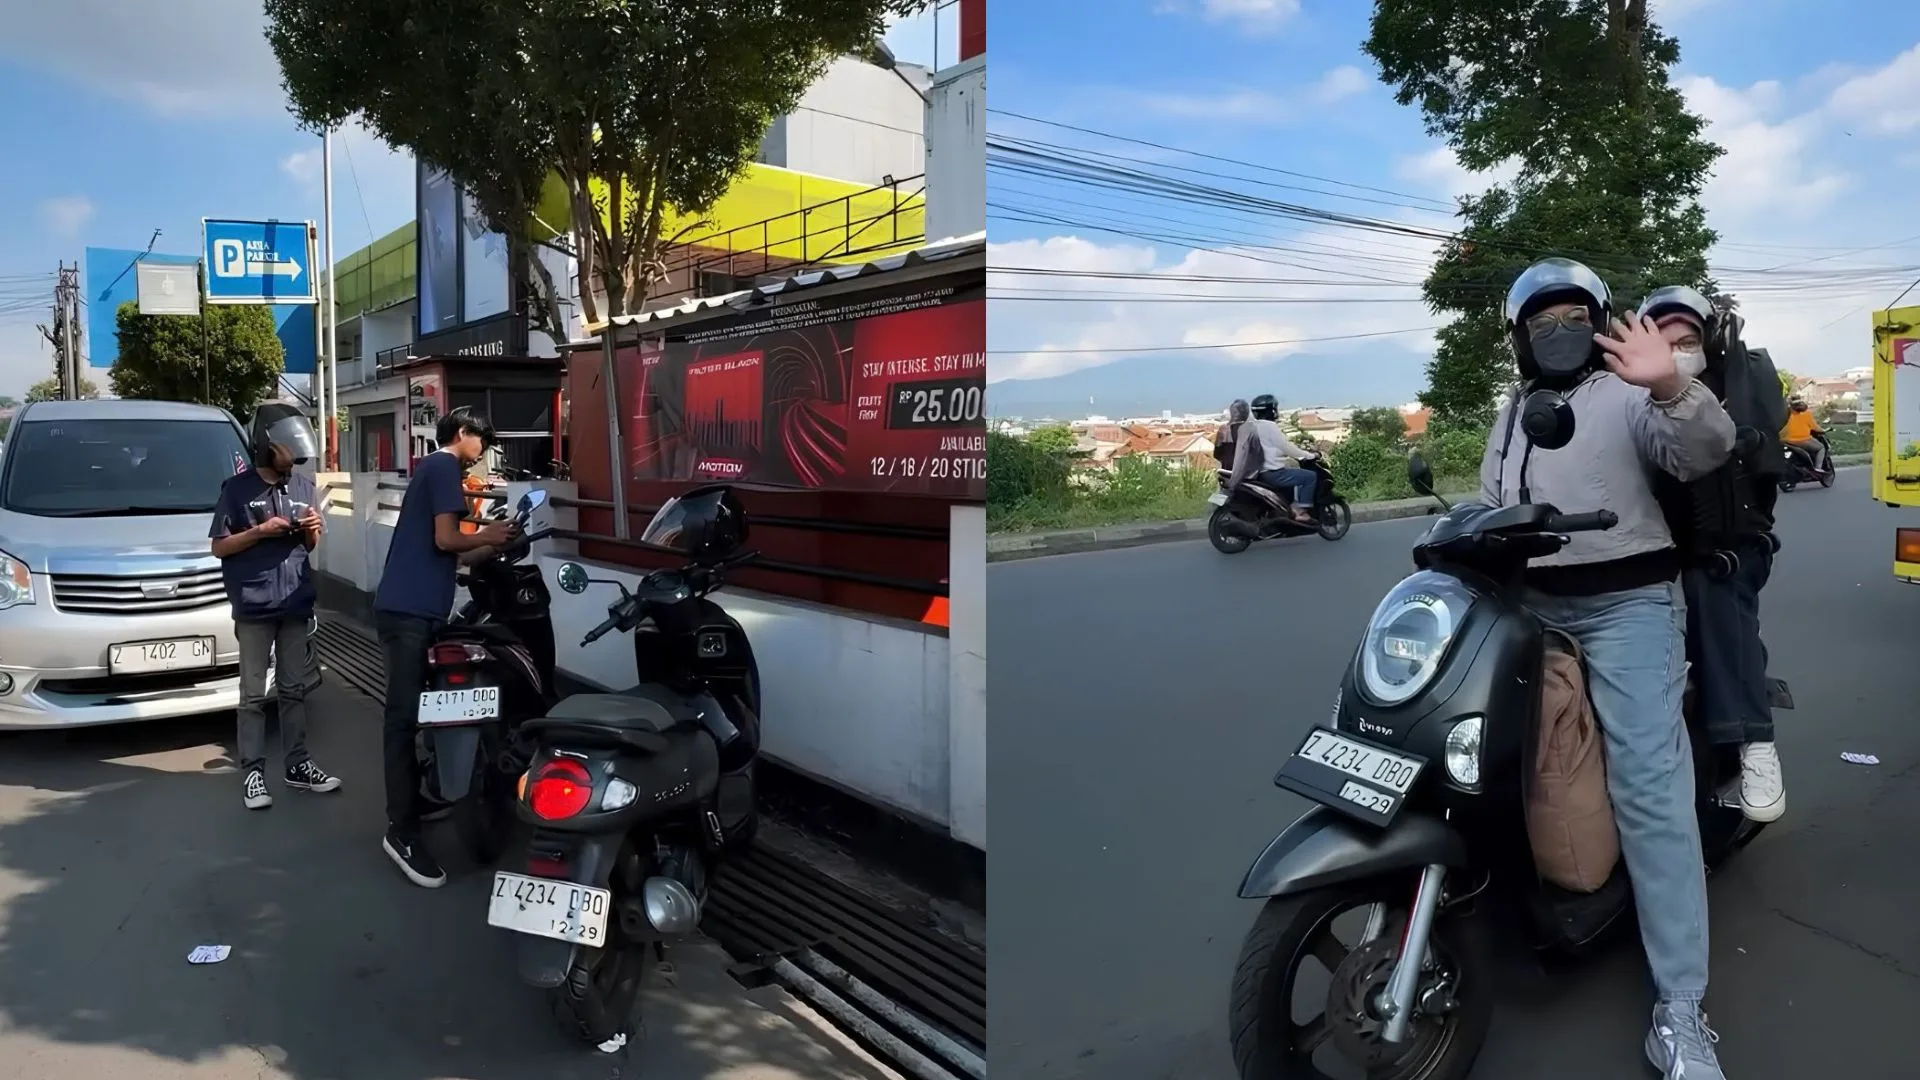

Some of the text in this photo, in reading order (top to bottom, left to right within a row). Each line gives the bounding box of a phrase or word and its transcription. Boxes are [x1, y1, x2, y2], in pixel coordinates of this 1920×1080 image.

[934, 354, 959, 372] STAY
[912, 386, 987, 423] 25.00
[870, 457, 886, 476] 12
[930, 457, 949, 478] 20
[114, 646, 123, 664] Z
[141, 642, 177, 661] 1402
[422, 694, 429, 707] Z
[1303, 735, 1413, 788] Z 4234 DBO
[496, 877, 507, 898] Z
[514, 880, 557, 906] 4234
